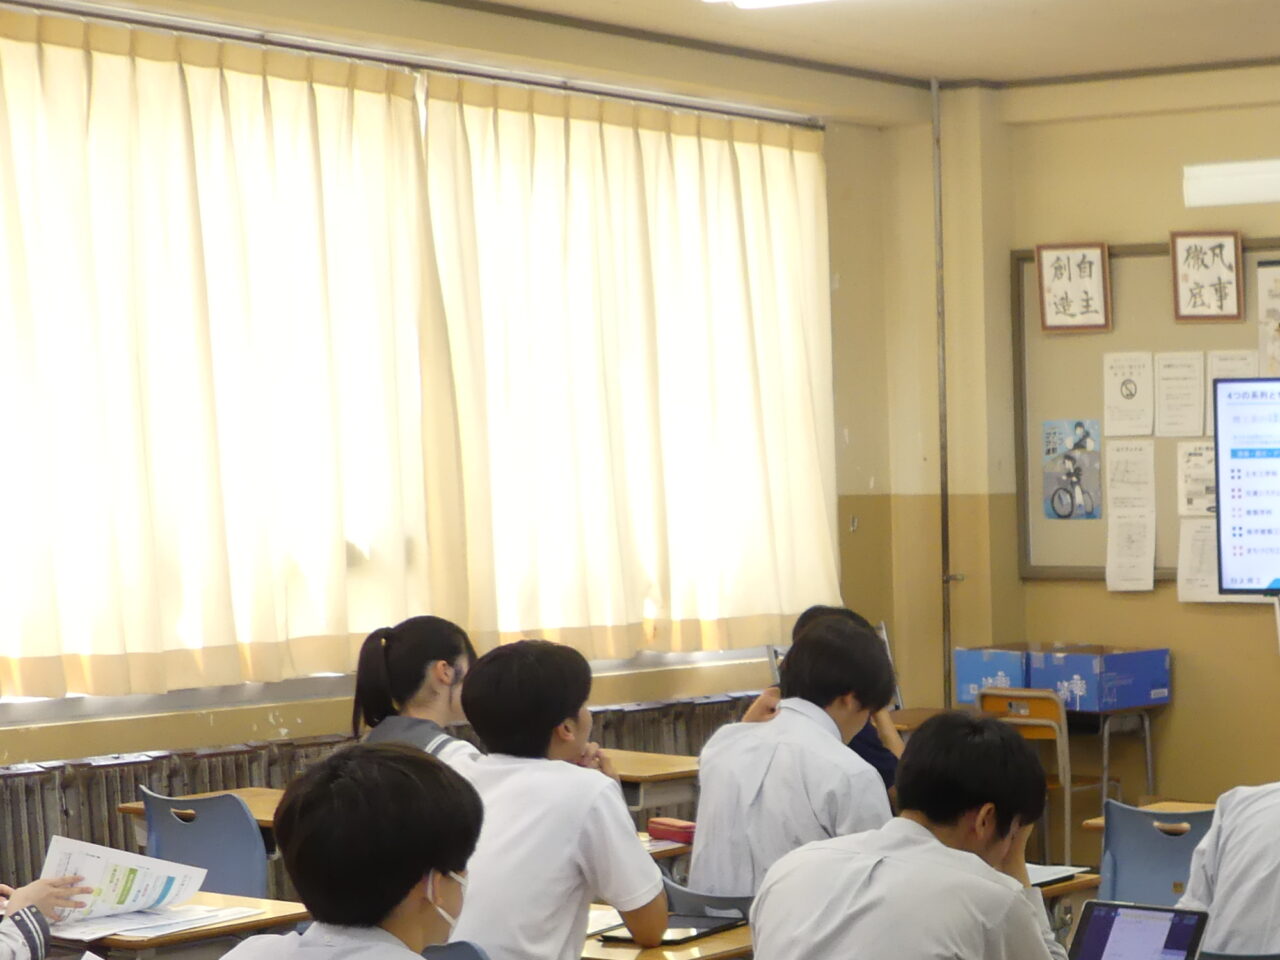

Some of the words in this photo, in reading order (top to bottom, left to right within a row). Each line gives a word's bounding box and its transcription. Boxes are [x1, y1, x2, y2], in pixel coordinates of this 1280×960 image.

[1051, 255, 1077, 318] 創造
[1076, 253, 1100, 315] 自主
[1208, 242, 1233, 311] 凡事
